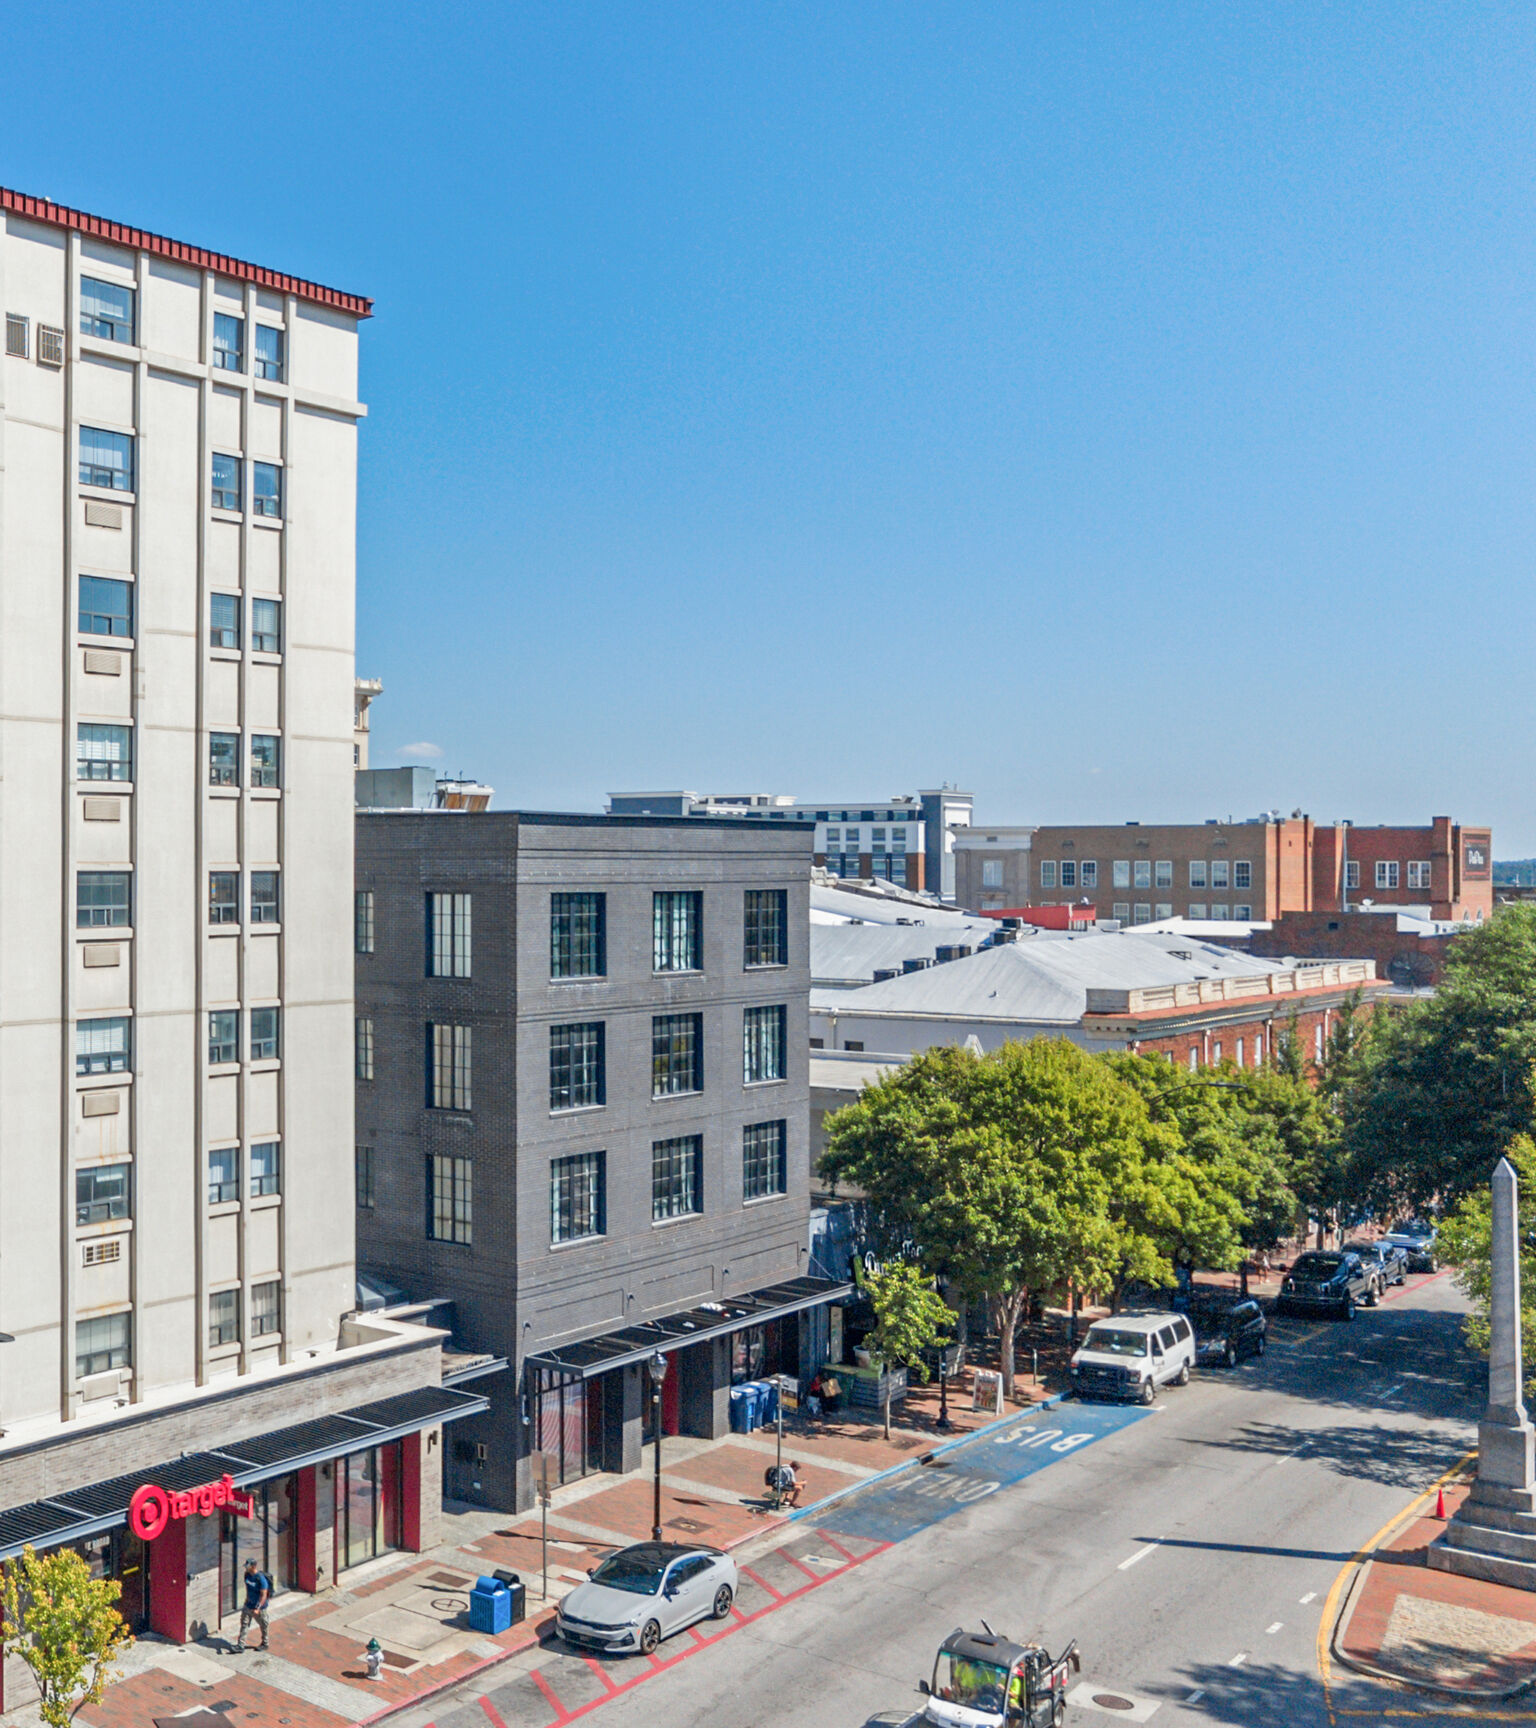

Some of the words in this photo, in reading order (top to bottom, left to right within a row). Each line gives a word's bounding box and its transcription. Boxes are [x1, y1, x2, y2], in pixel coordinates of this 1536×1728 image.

[994, 1425, 1095, 1453] BUS
[167, 1473, 234, 1520] target
[885, 1471, 1001, 1503] ONLY
